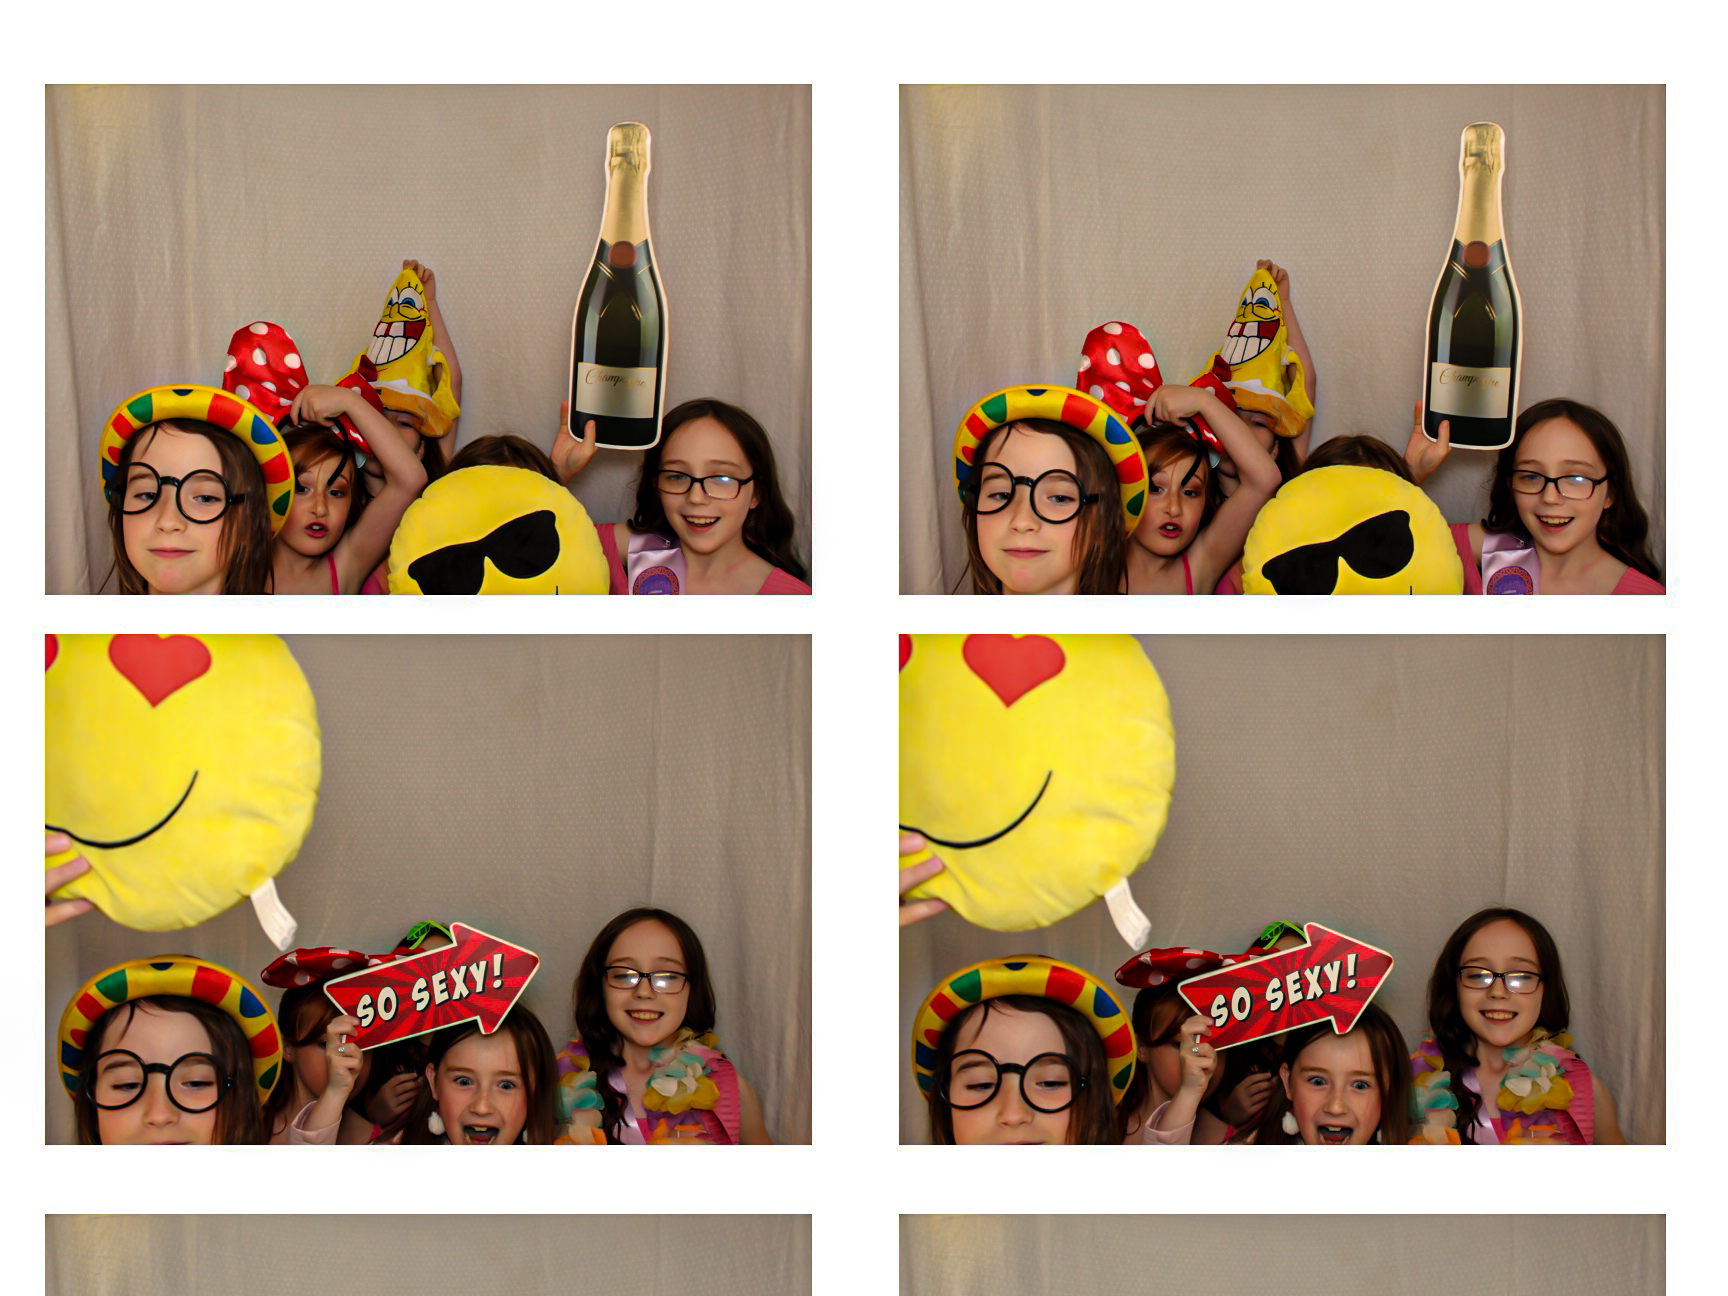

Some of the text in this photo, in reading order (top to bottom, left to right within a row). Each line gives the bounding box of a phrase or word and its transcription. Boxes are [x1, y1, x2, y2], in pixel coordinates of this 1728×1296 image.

[585, 367, 647, 389] Champagne
[356, 953, 505, 1028] SO SEXY!
[1210, 953, 1359, 1028] SO SEXY!
